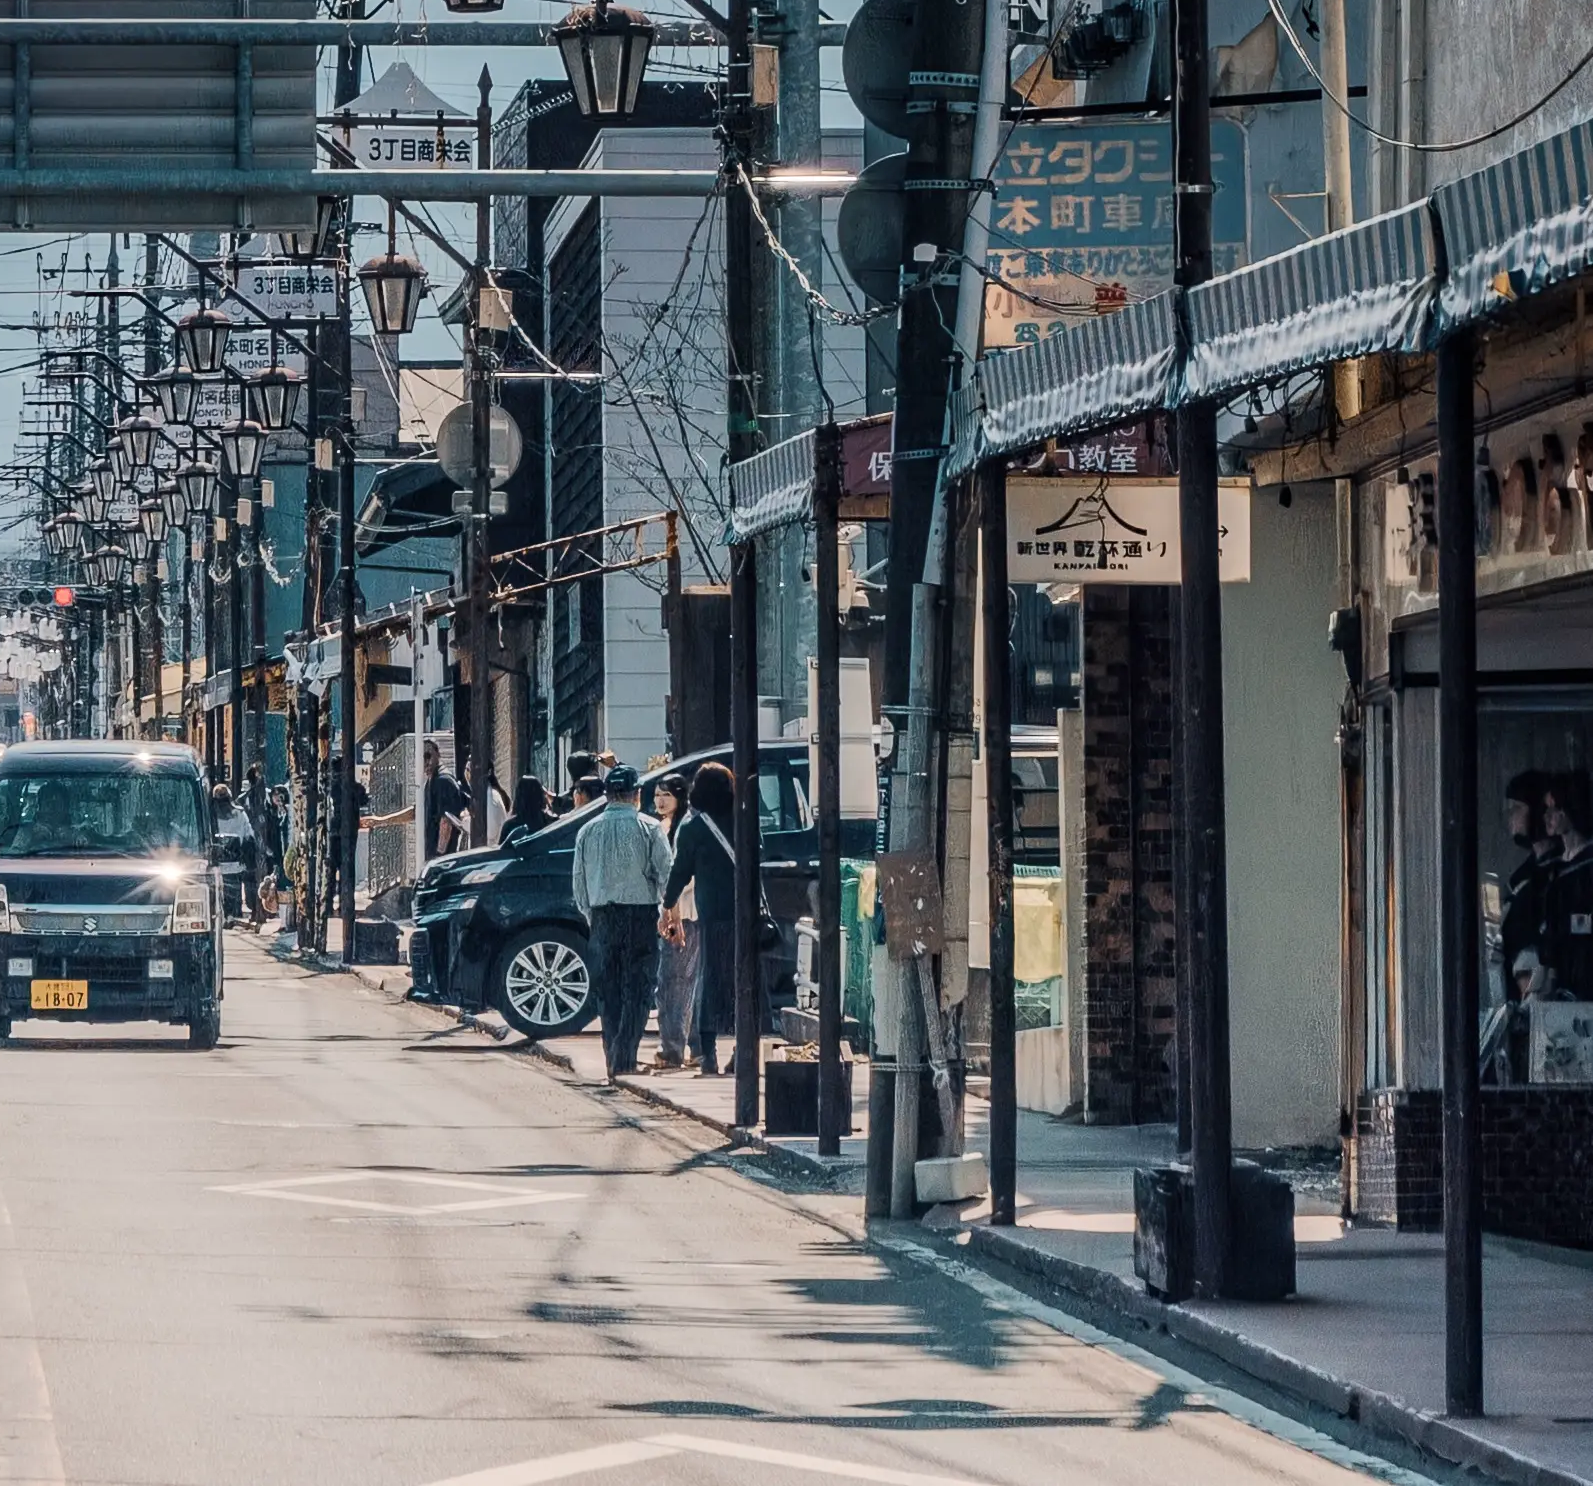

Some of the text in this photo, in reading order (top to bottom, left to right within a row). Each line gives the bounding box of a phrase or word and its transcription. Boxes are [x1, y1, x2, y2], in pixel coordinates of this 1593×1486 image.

[368, 137, 471, 163] 3丁目商栄会
[253, 276, 335, 295] 3丁目商栄会
[1016, 540, 1167, 559] 新世界 乾杯通り
